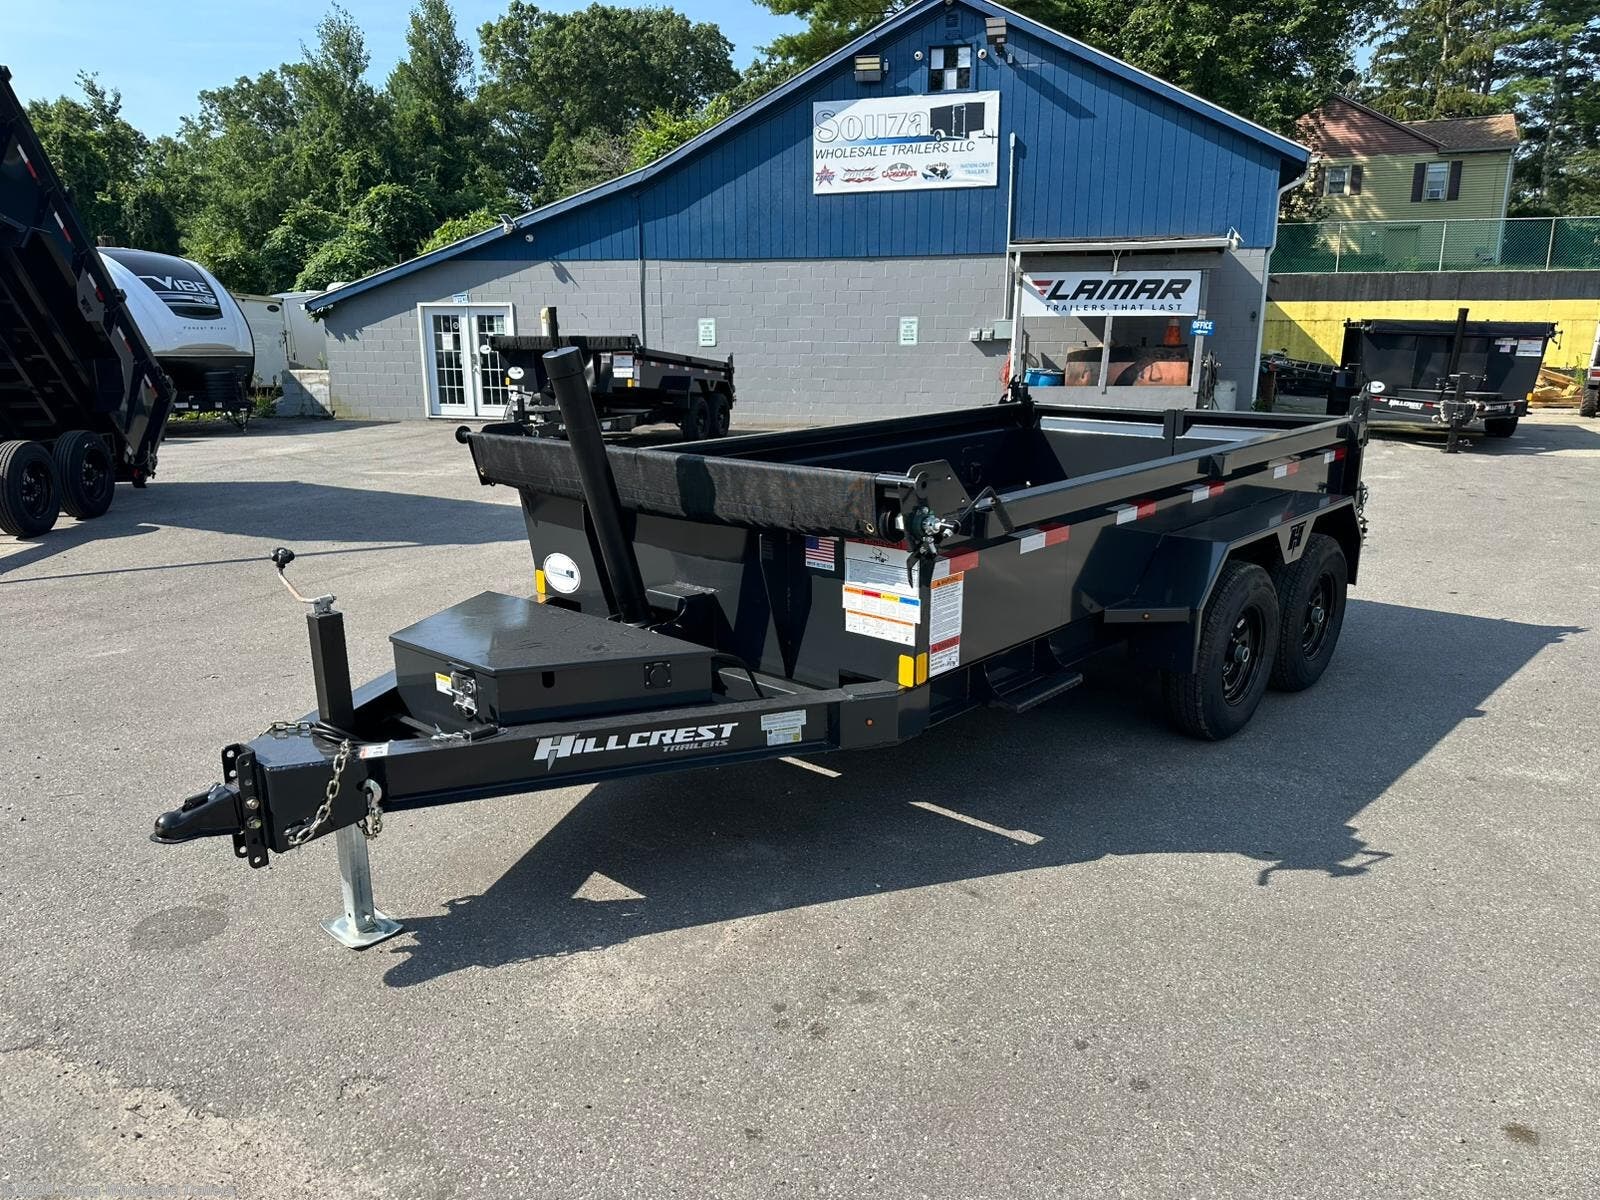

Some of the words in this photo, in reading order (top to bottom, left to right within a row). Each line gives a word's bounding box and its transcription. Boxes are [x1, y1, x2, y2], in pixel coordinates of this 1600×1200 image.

[815, 110, 930, 143] Souza
[815, 146, 887, 160] WHOLESALE
[891, 142, 950, 156] TRAILERS
[952, 140, 976, 153] LLC
[148, 276, 213, 293] VIBE
[1045, 278, 1192, 301] LAMAR
[1046, 304, 1106, 312] TRAILERS
[1114, 303, 1145, 311] THAT
[1151, 303, 1183, 311] LAST
[1192, 321, 1213, 330] OFFICE
[533, 722, 739, 771] HILLCREST
[662, 738, 729, 753] TRAILERS
